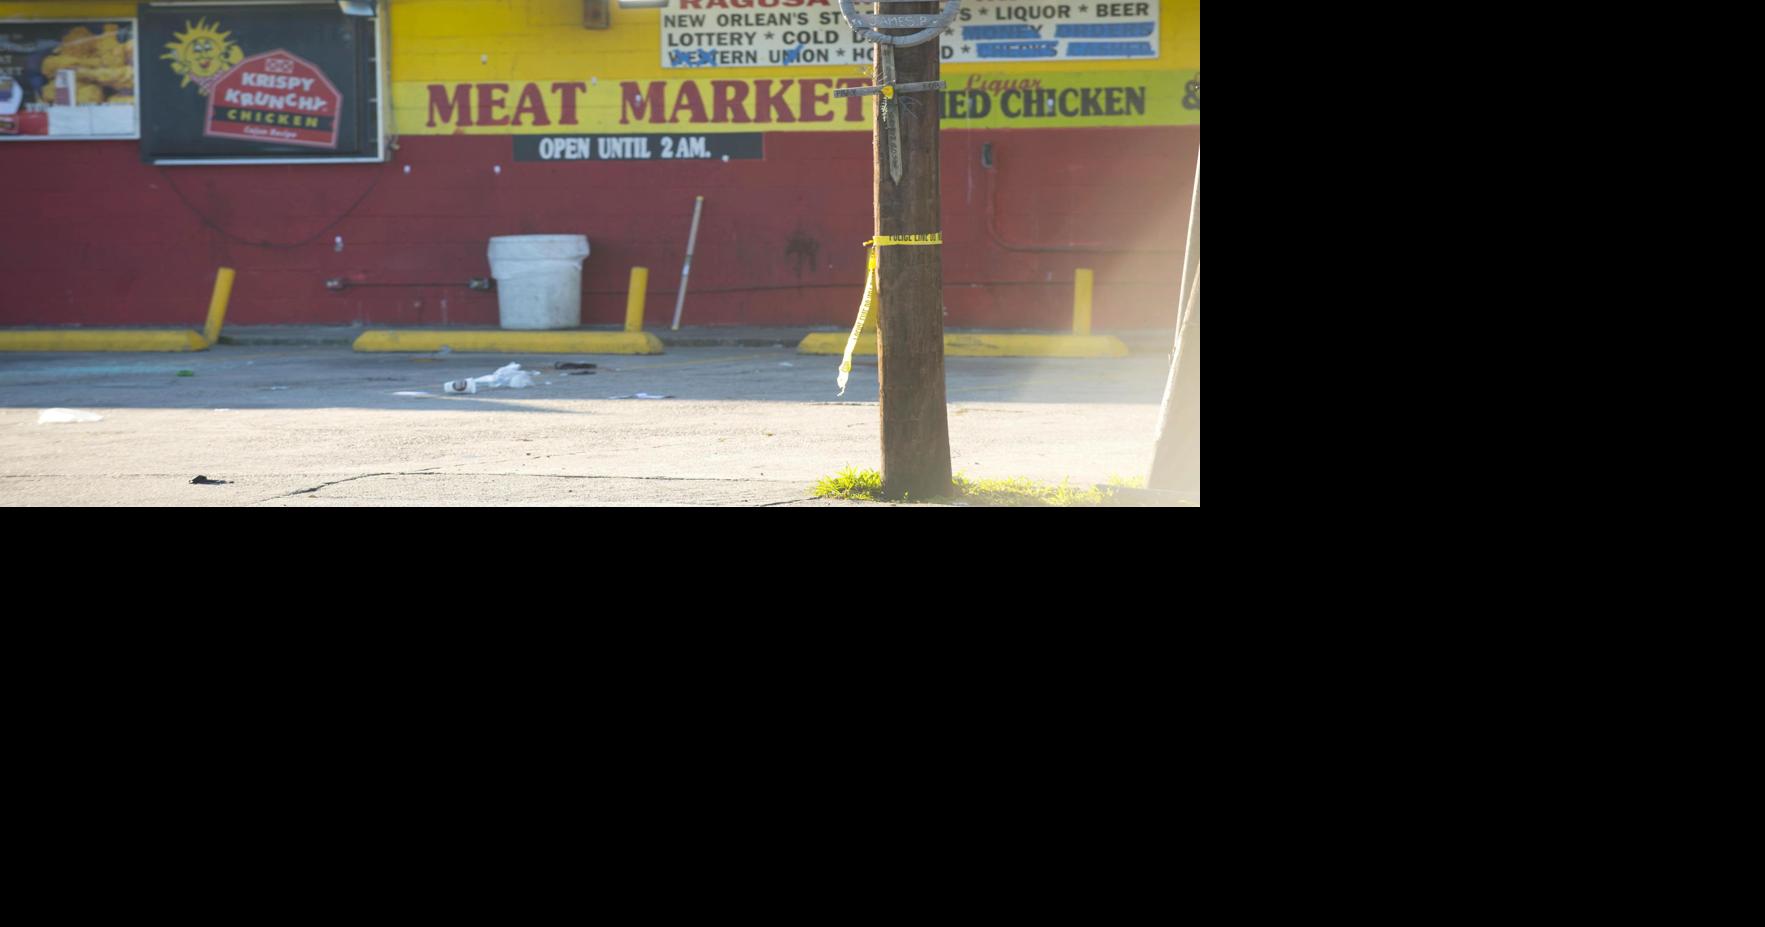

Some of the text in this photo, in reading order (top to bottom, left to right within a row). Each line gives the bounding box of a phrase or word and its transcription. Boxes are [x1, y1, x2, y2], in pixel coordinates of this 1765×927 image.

[664, 14, 706, 28] NEW
[716, 11, 809, 28] ORLEAN'S
[995, 2, 1149, 21] LIQUOR BEER
[667, 31, 757, 47] LOTTERY
[782, 28, 839, 45] COLD
[241, 72, 315, 92] KRISPY
[964, 73, 1042, 96] Liquor
[223, 88, 328, 111] KRUNCHY
[426, 79, 874, 128] MEAT MARKET
[1000, 86, 1147, 118] CHICKEN
[227, 109, 319, 128] CHICKEN
[539, 137, 590, 160] OPEN
[597, 137, 651, 160] UNTIL
